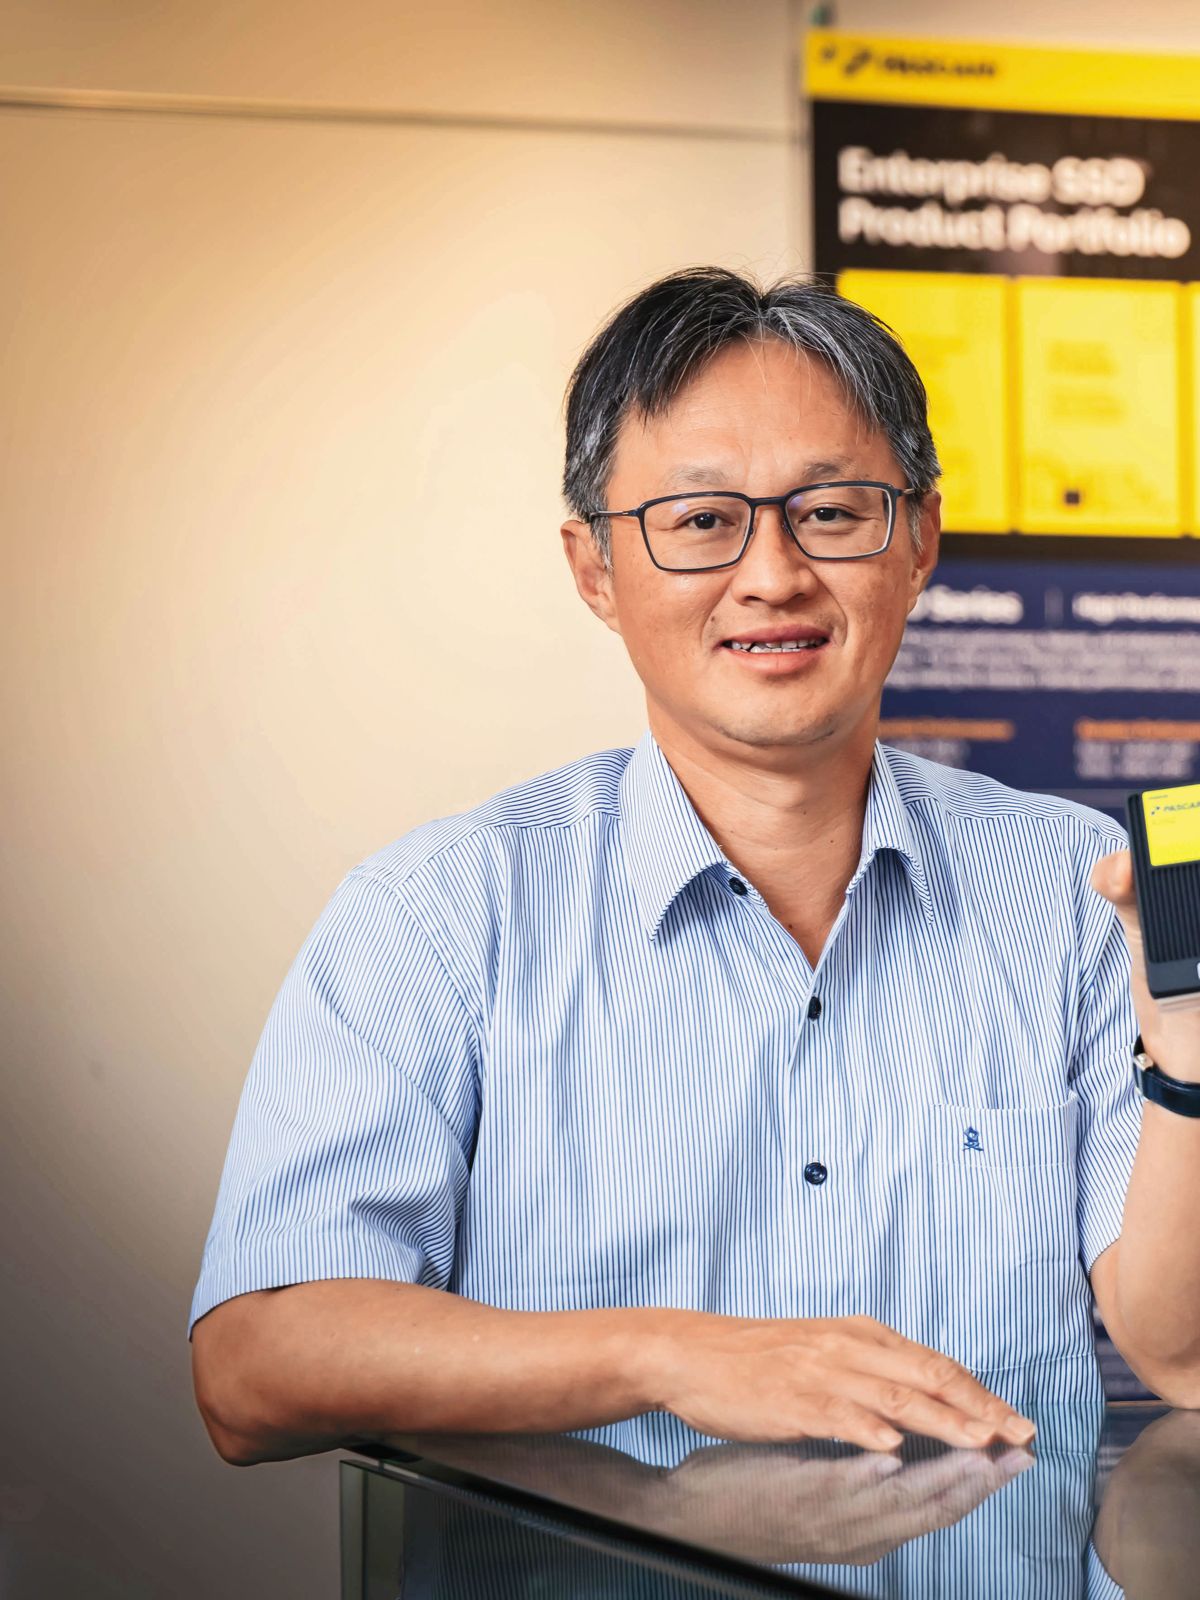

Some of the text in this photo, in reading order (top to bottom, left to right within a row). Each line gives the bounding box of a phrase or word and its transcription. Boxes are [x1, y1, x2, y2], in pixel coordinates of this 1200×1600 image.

[839, 147, 1145, 206] Enterprise SSD
[839, 198, 1190, 257] Product Portfolio
